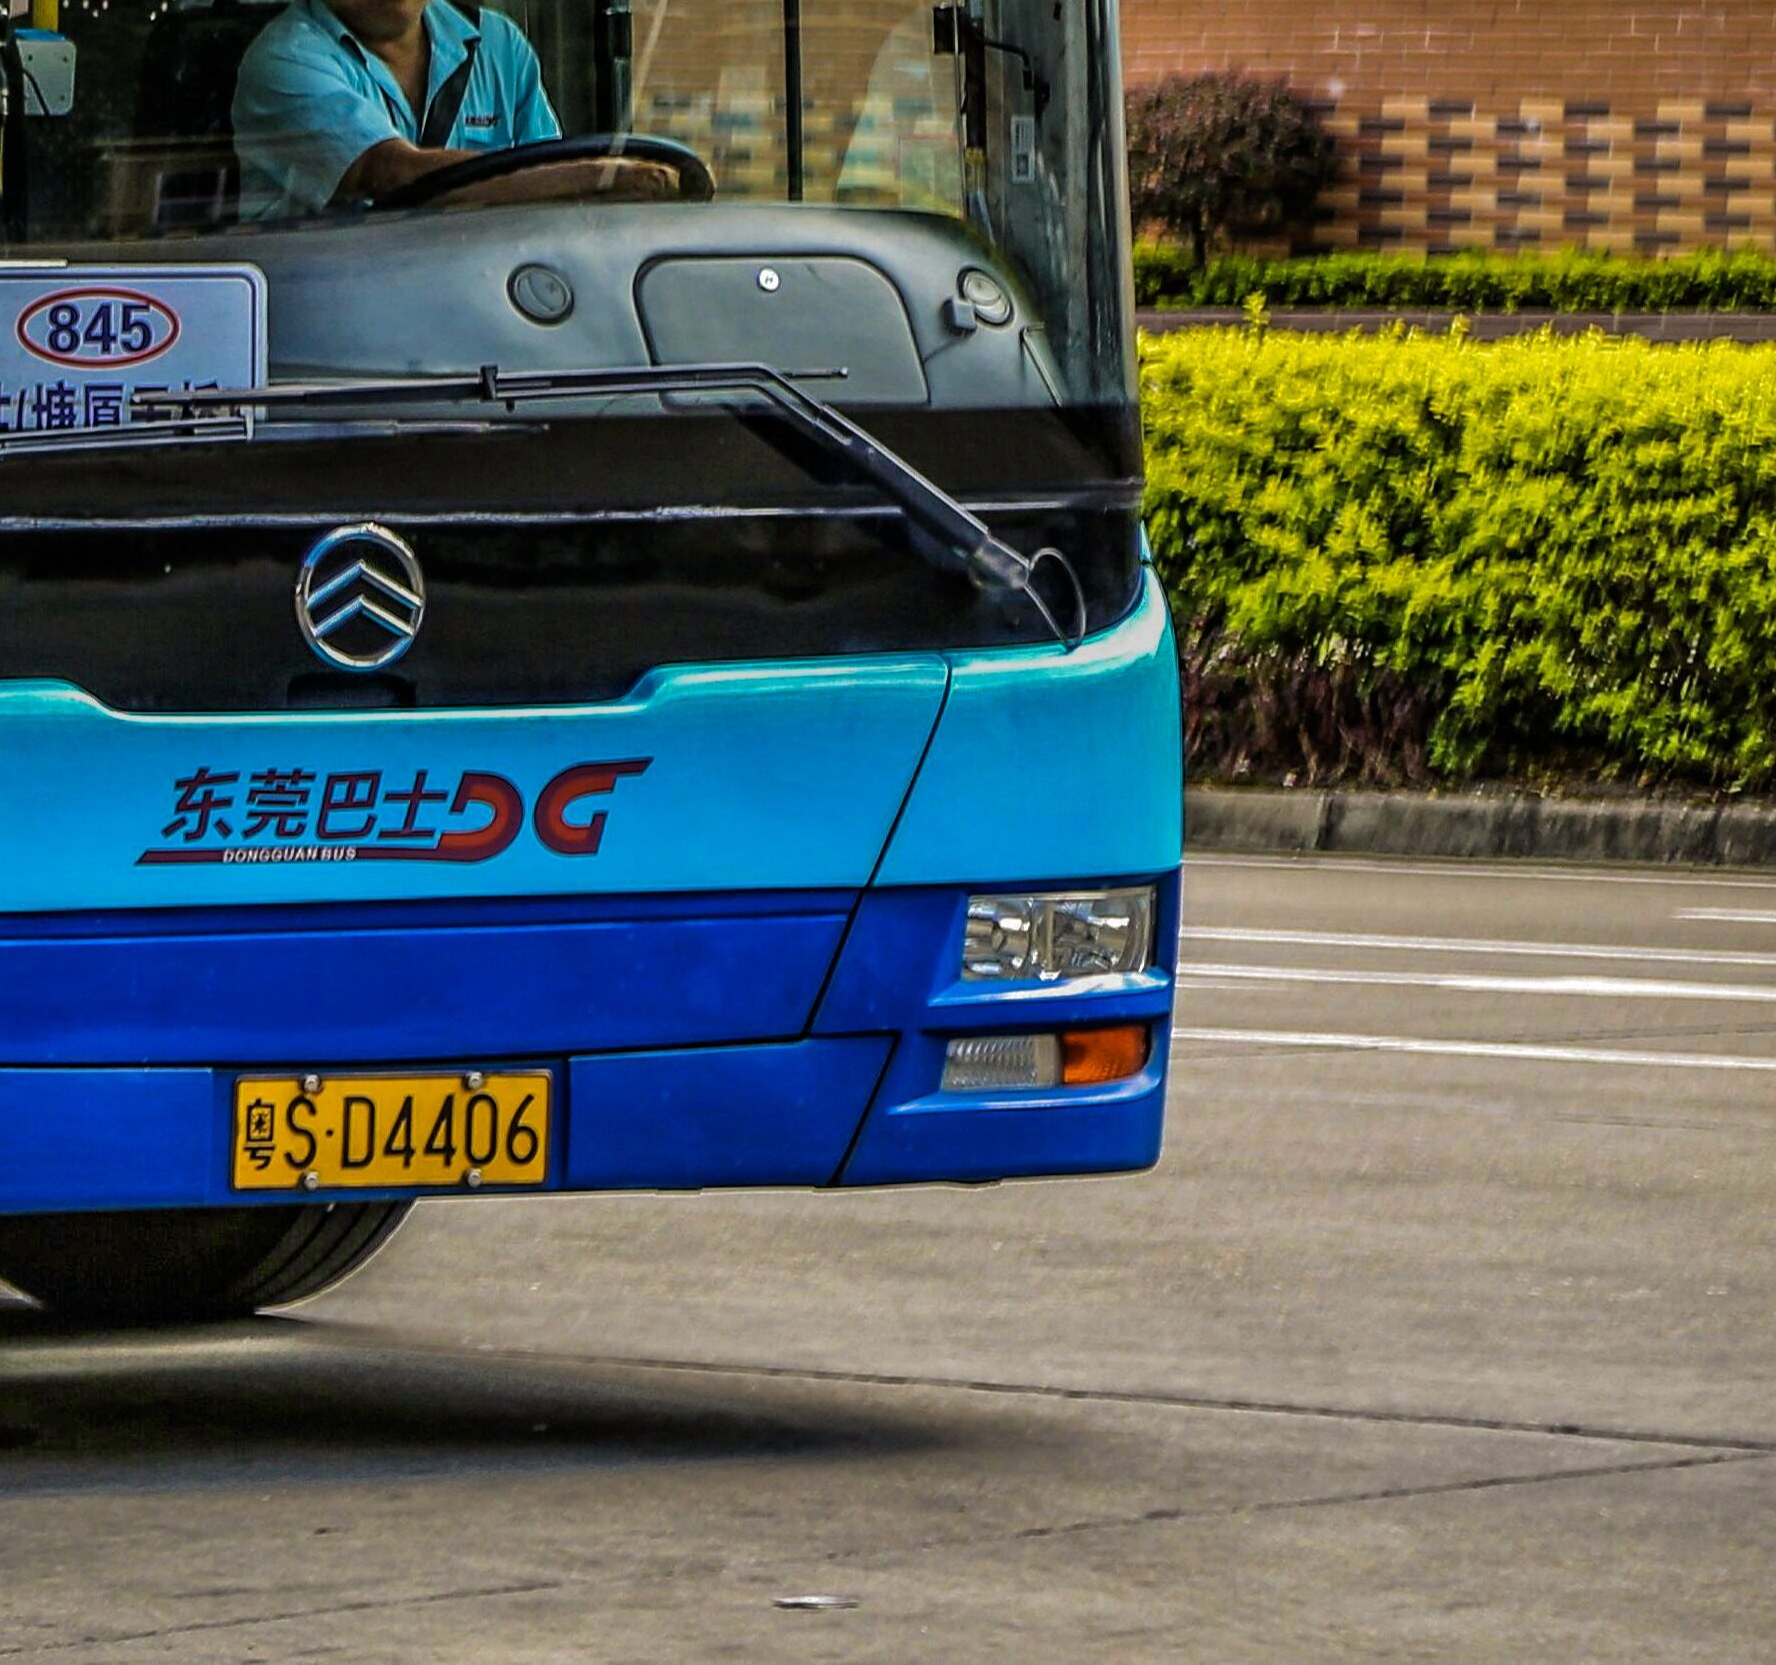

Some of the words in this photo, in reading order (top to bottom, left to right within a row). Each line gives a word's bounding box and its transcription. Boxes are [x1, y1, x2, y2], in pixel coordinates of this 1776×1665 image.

[47, 301, 155, 356] 845
[162, 765, 449, 842] 东莞巴士
[223, 847, 317, 863] DONGGUAN
[320, 847, 357, 862] BUS
